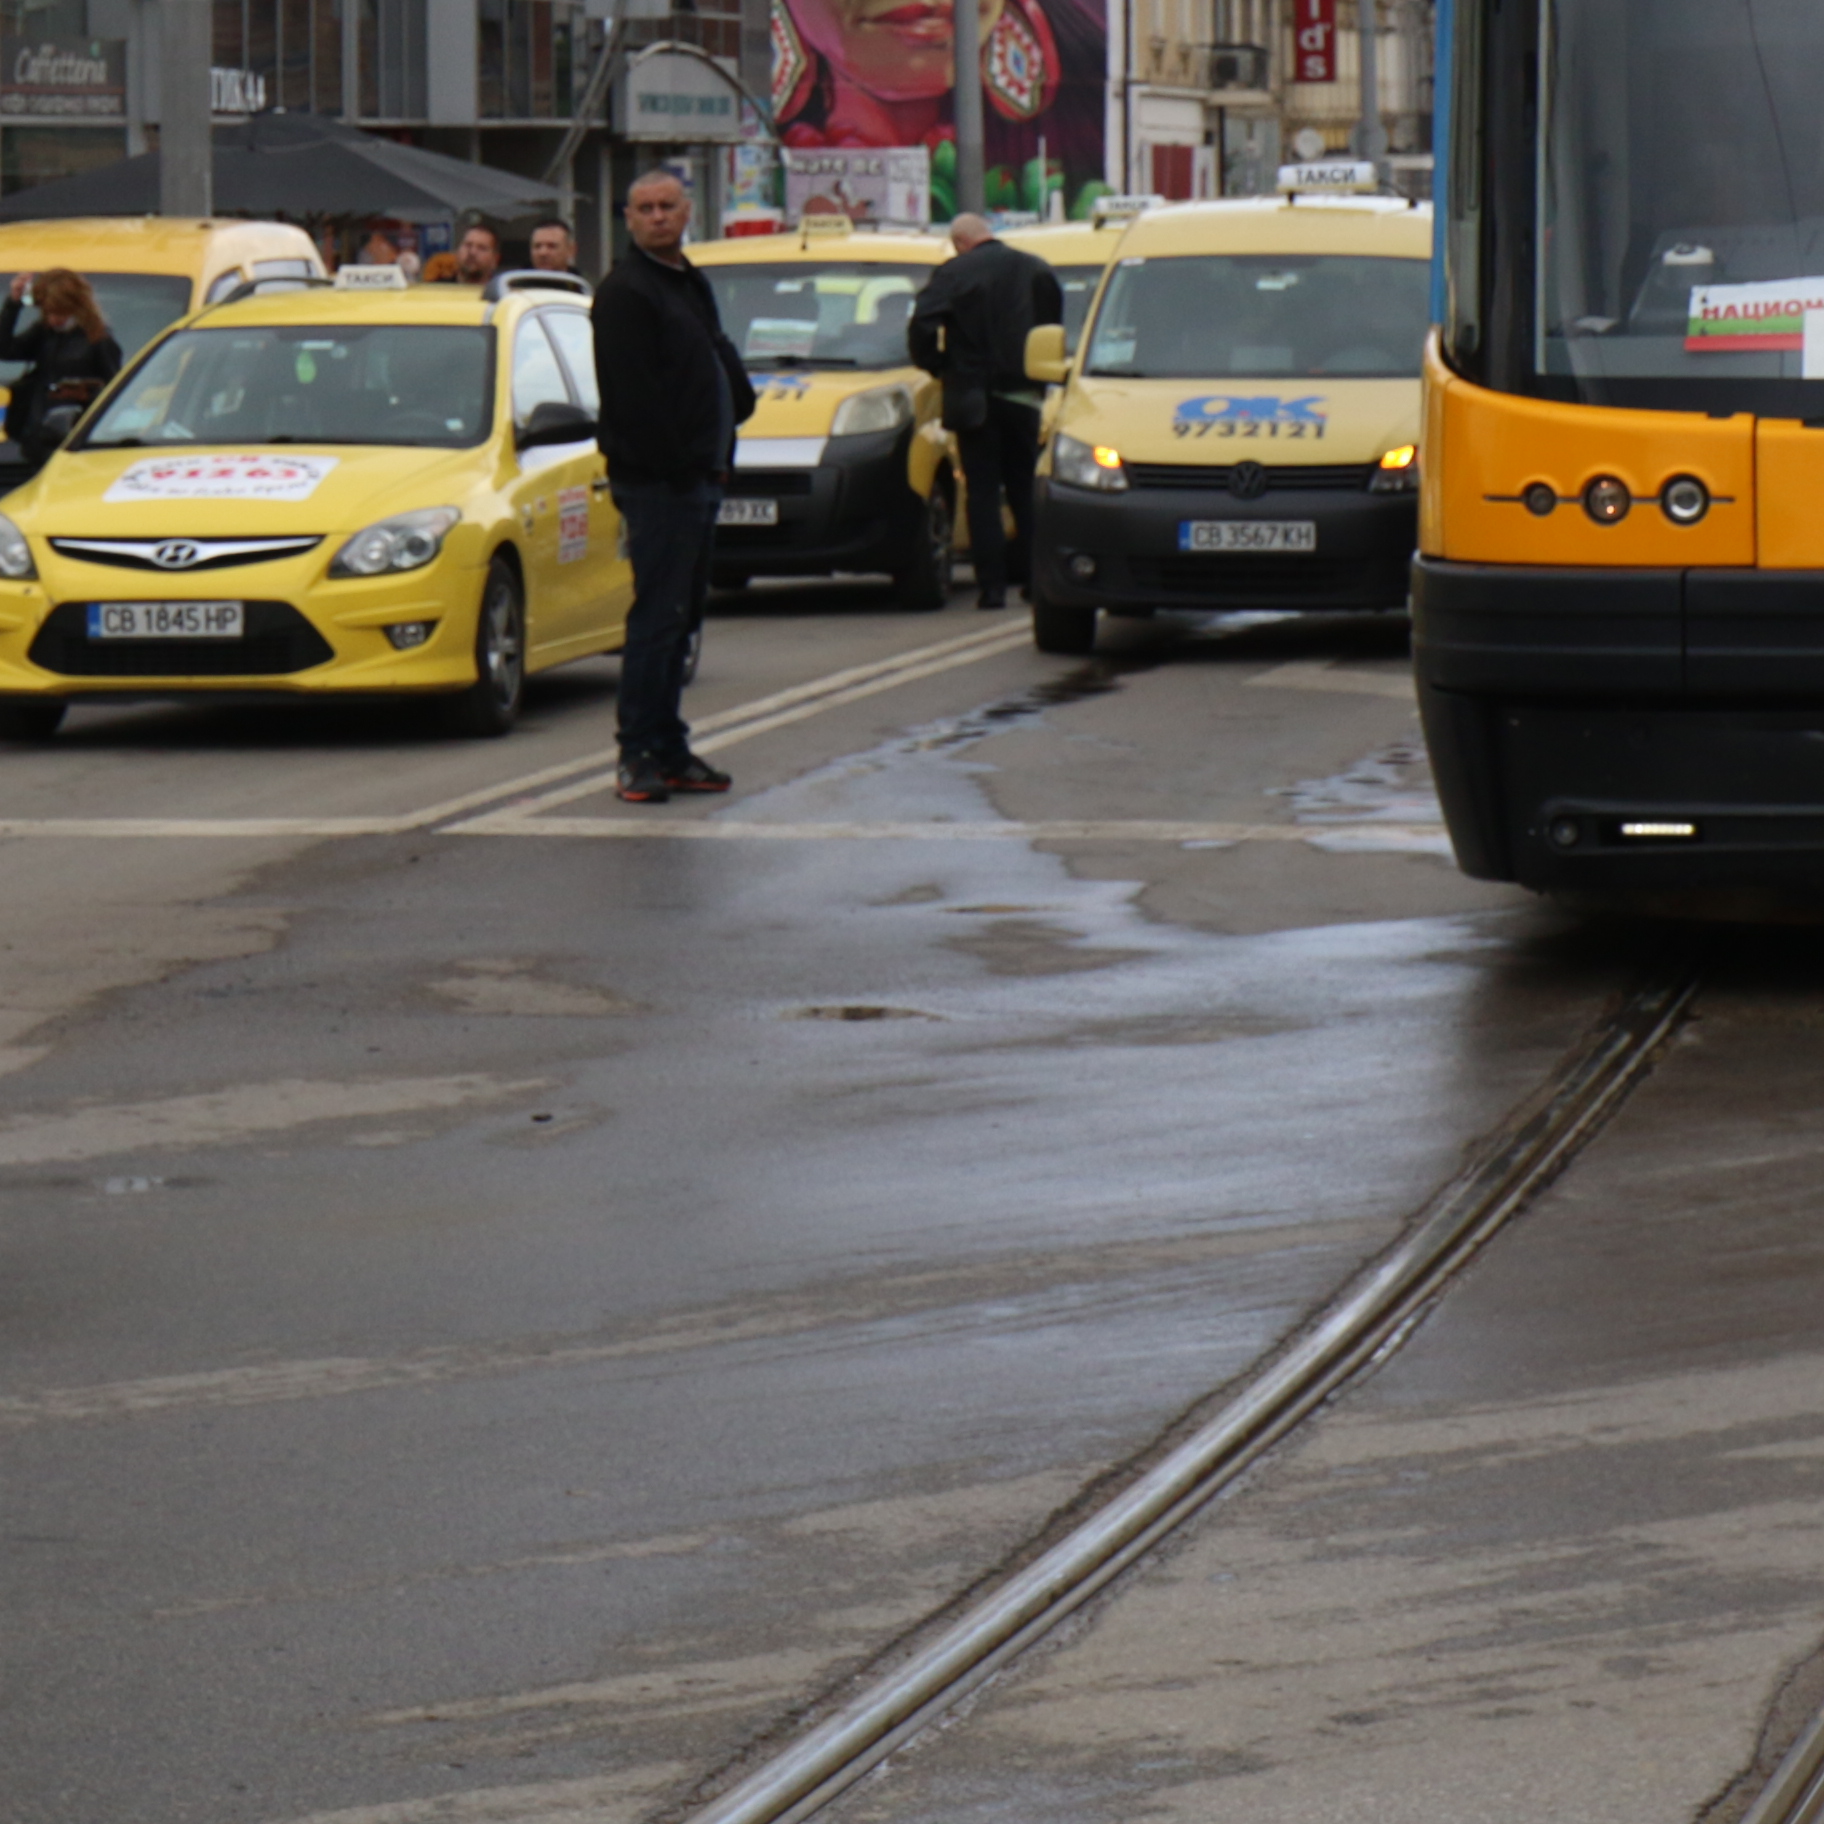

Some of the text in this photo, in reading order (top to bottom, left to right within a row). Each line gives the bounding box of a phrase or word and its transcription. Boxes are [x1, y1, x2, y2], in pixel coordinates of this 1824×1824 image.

[1295, 167, 1357, 183] ТАКСИ
[1173, 421, 1325, 439] 9732121
[1226, 526, 1279, 545] 3567
[103, 606, 238, 633] CB 1845 HP
